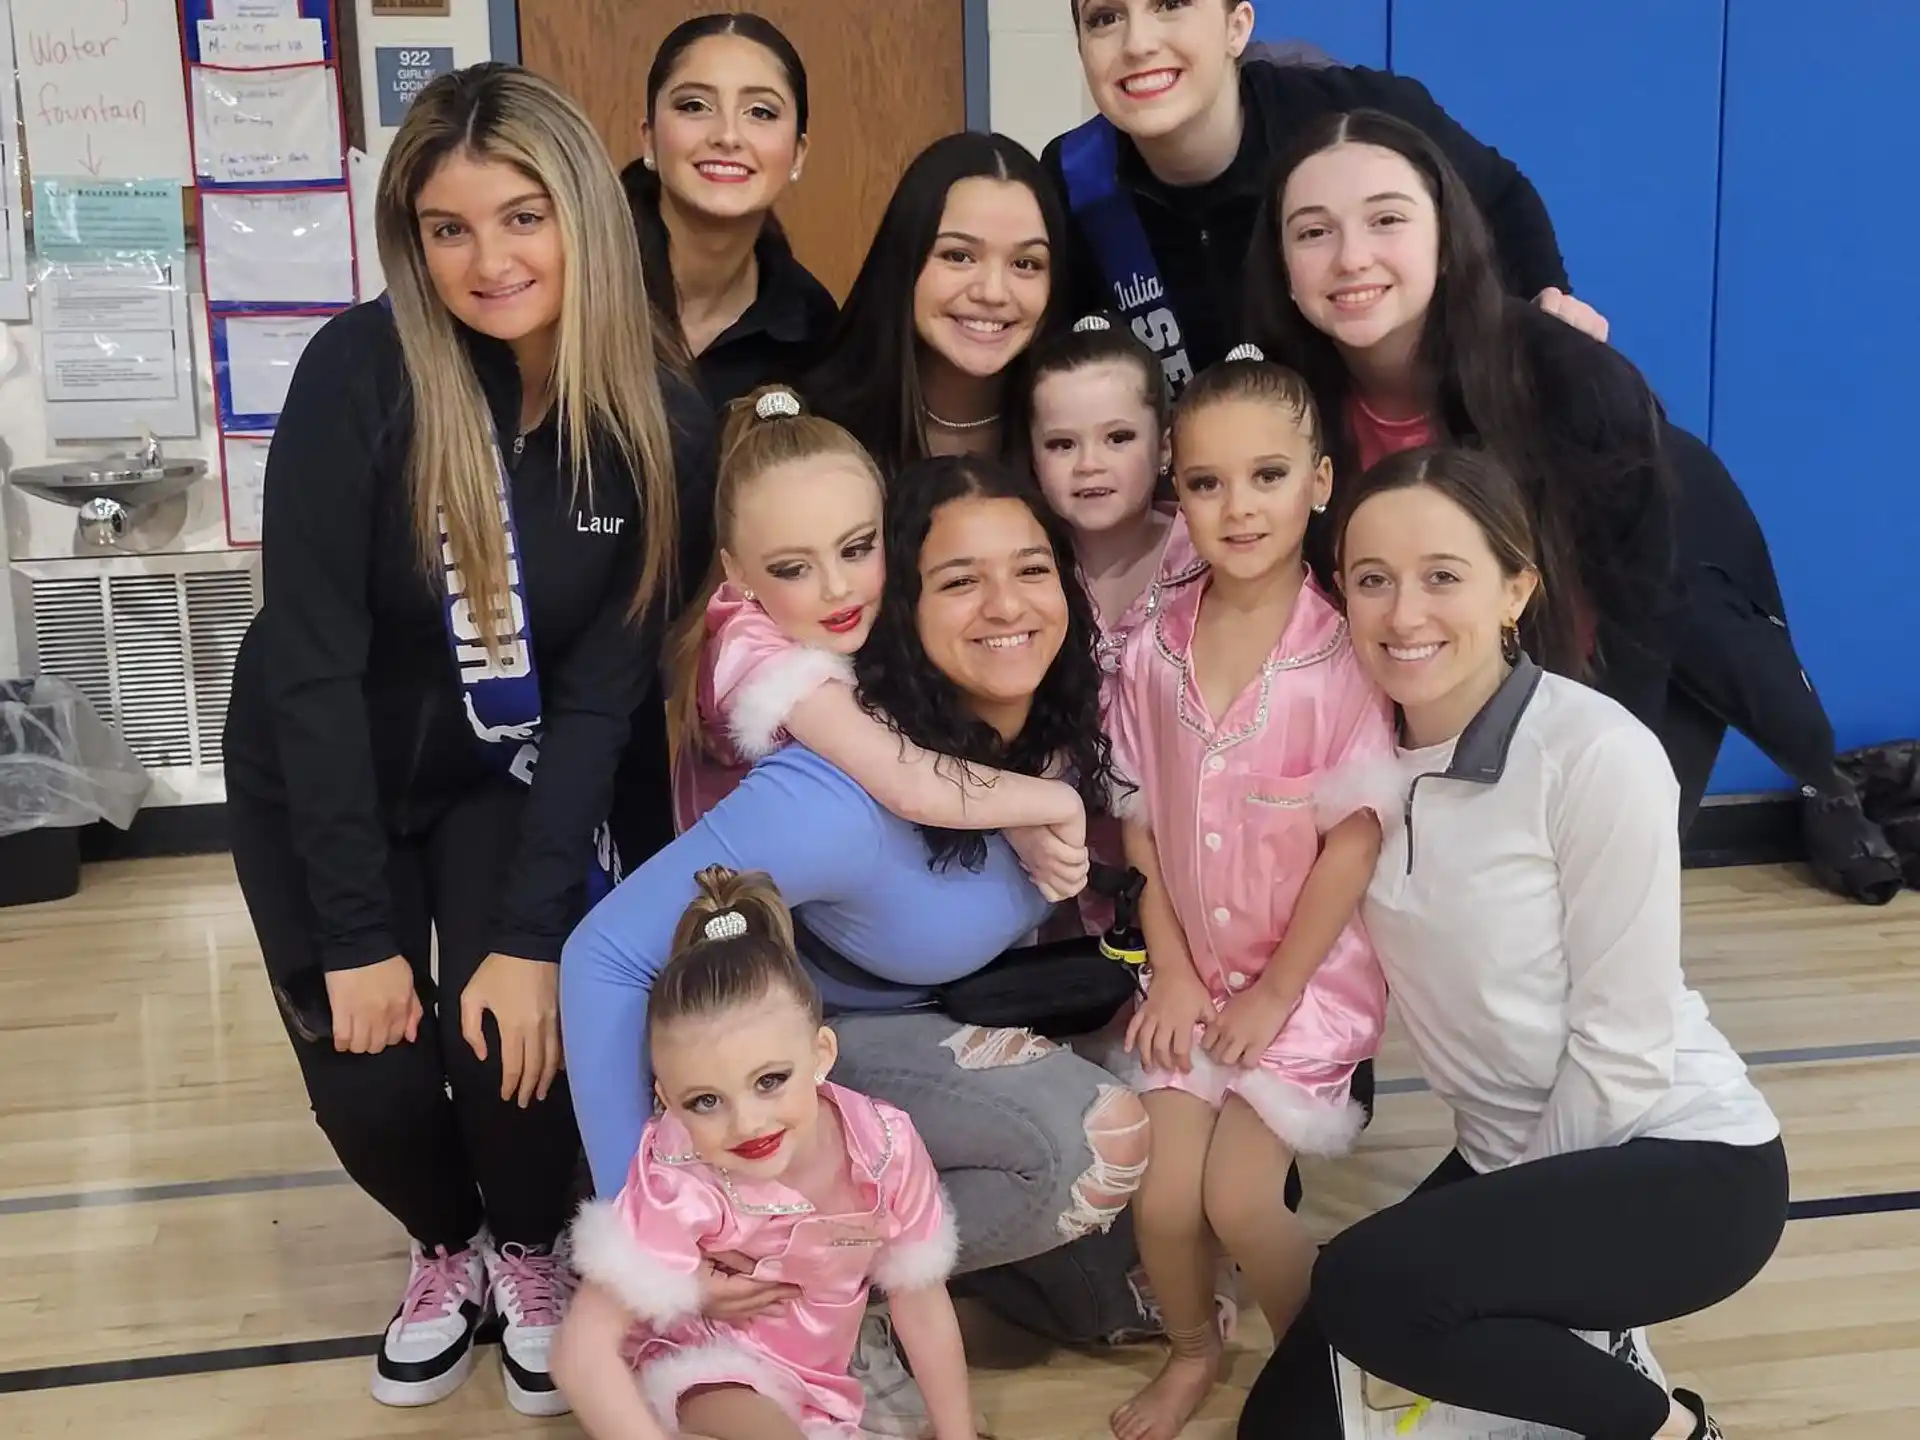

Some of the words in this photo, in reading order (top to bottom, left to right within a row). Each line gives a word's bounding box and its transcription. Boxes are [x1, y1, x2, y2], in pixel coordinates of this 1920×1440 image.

[28, 27, 119, 66] Water
[399, 50, 431, 66] 922
[37, 81, 146, 128] fountain
[1114, 272, 1164, 312] Julia
[576, 510, 625, 536] Laur
